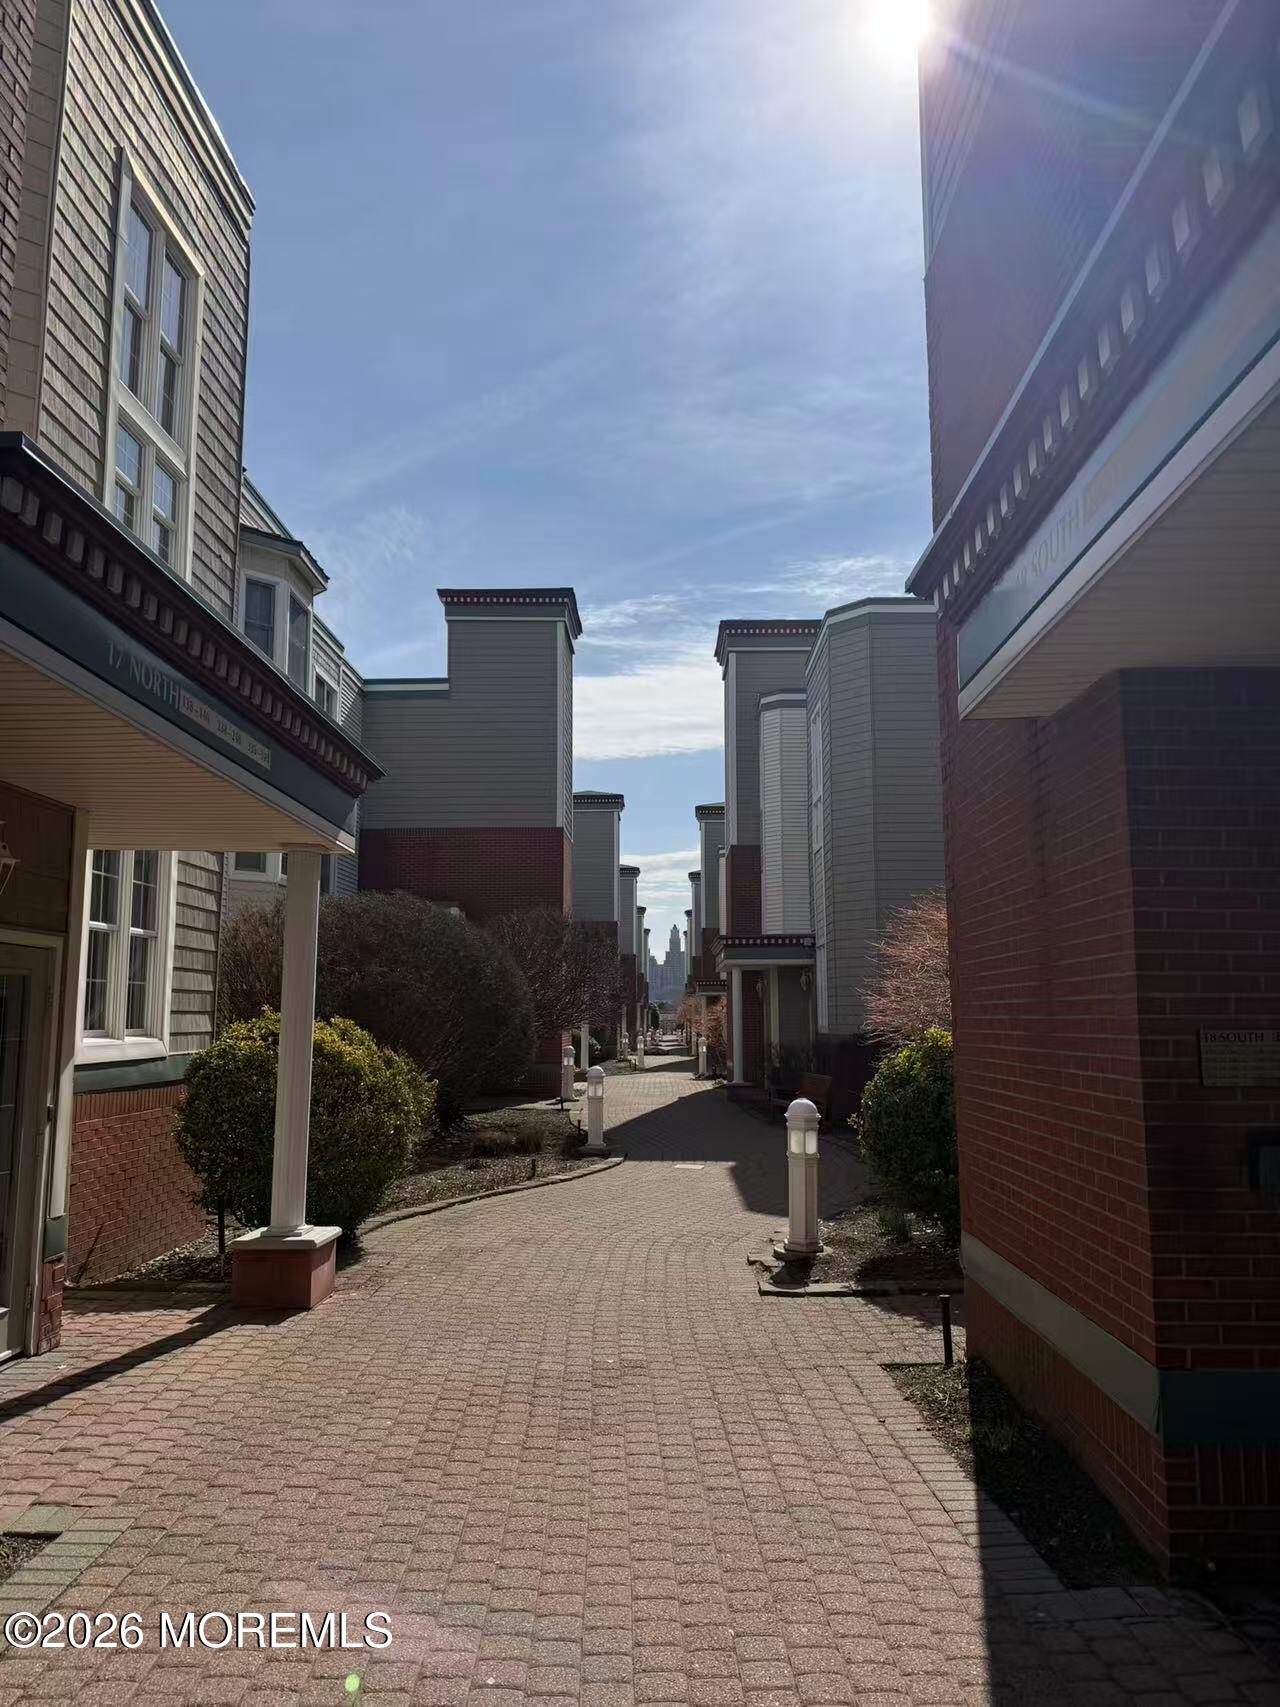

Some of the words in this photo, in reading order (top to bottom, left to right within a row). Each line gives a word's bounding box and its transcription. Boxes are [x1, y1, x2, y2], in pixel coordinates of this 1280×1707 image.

[1032, 497, 1086, 576] SOUTH
[129, 655, 181, 709] NORTH
[1204, 1032, 1217, 1042] 18
[1218, 1031, 1265, 1042] SOUTH
